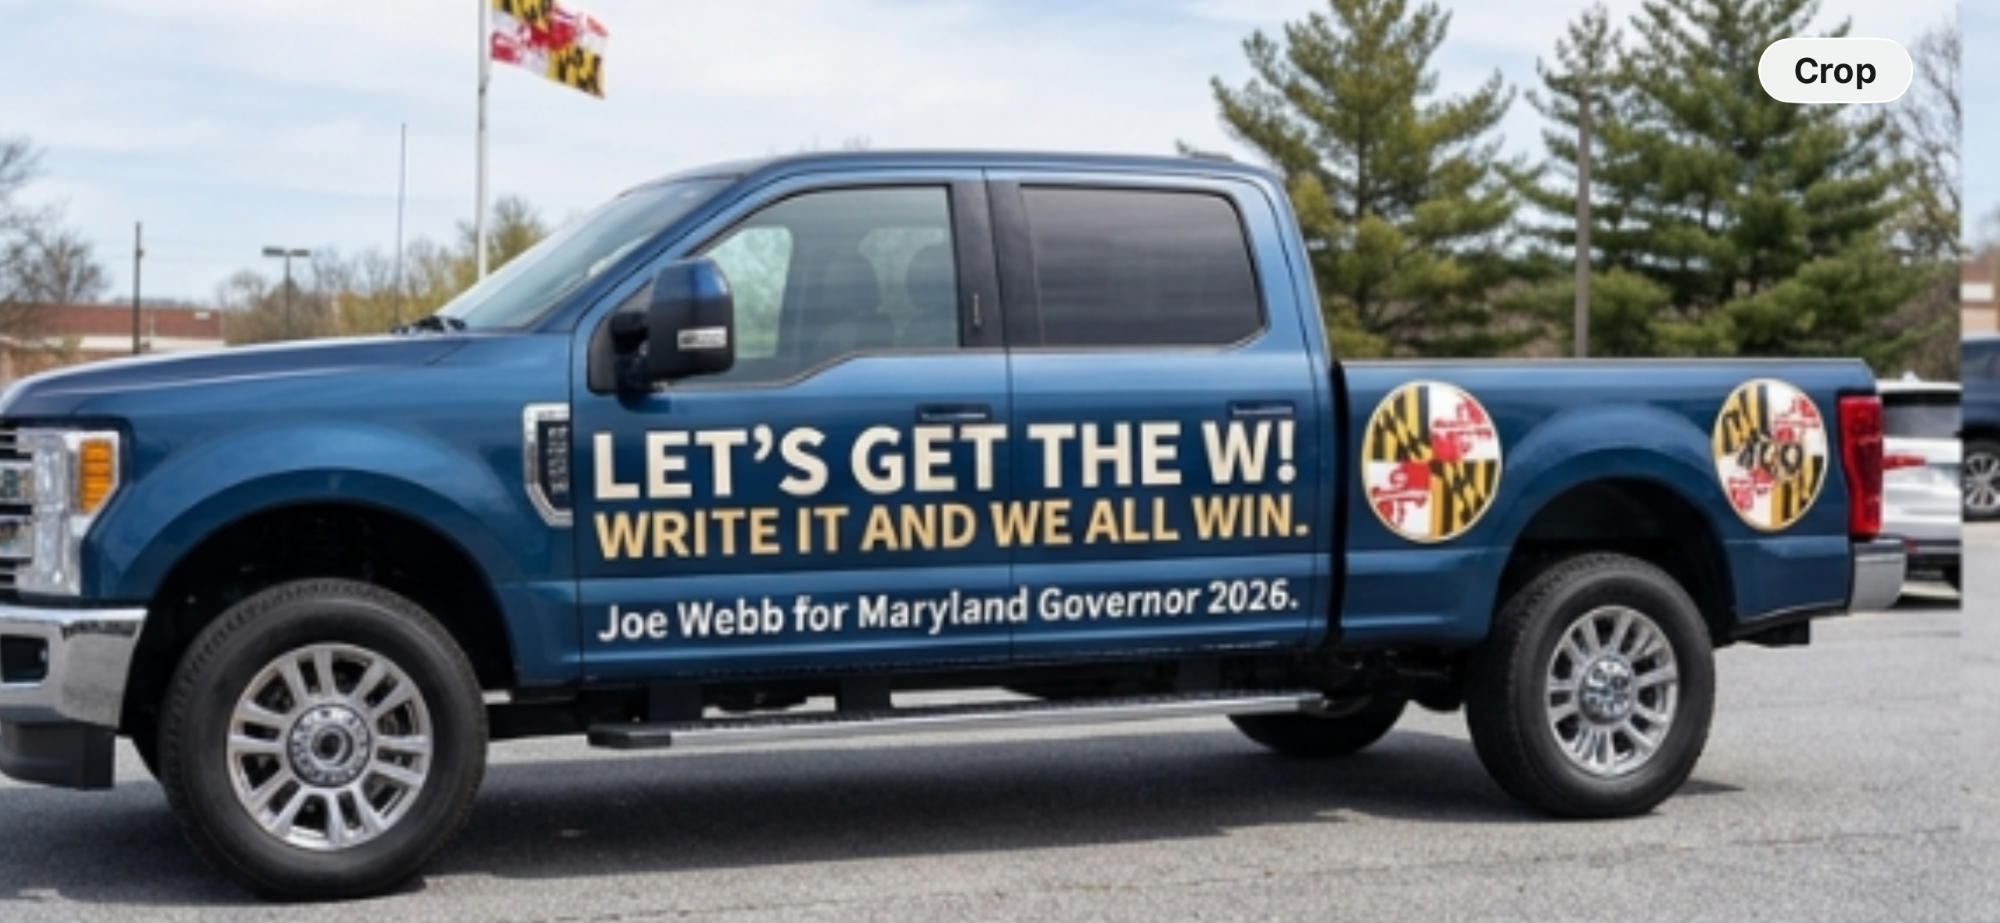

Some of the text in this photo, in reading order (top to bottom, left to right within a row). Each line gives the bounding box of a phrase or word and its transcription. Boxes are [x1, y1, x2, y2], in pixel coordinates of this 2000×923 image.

[593, 424, 829, 499] LET’S
[850, 424, 1007, 494] GET
[1027, 421, 1182, 488] THE
[1202, 420, 1296, 484] W!
[594, 493, 1309, 559] WRITE IT AND WE ALL WIN.
[598, 578, 1298, 641] Joe Webb for Maryland Governor 2026.
